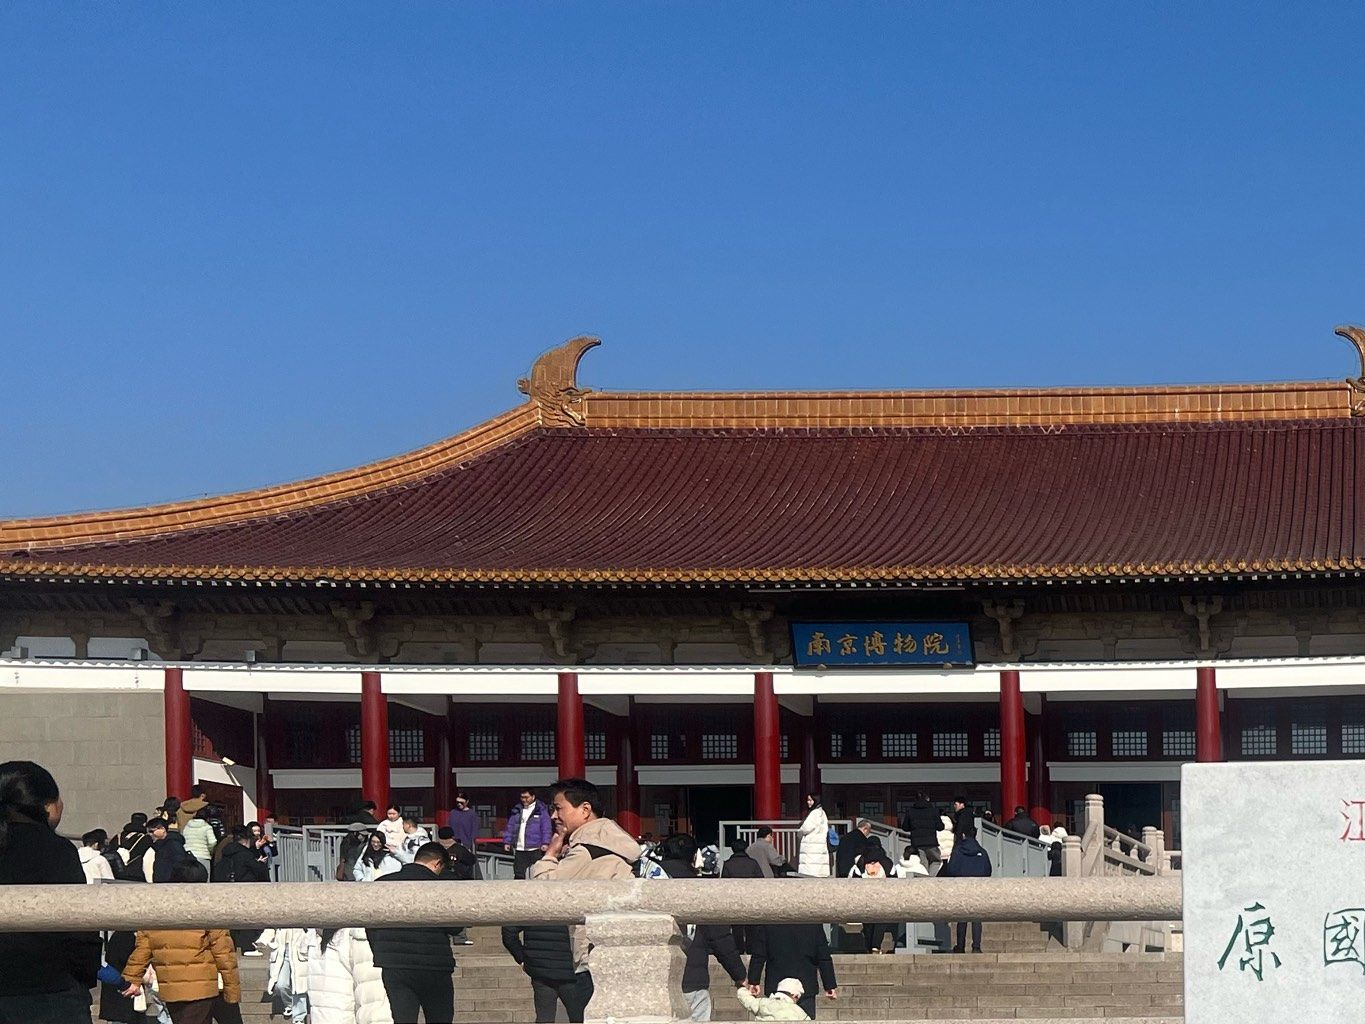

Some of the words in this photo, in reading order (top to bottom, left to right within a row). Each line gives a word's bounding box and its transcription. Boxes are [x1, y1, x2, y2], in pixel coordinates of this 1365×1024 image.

[807, 631, 949, 657] 南京博物院
